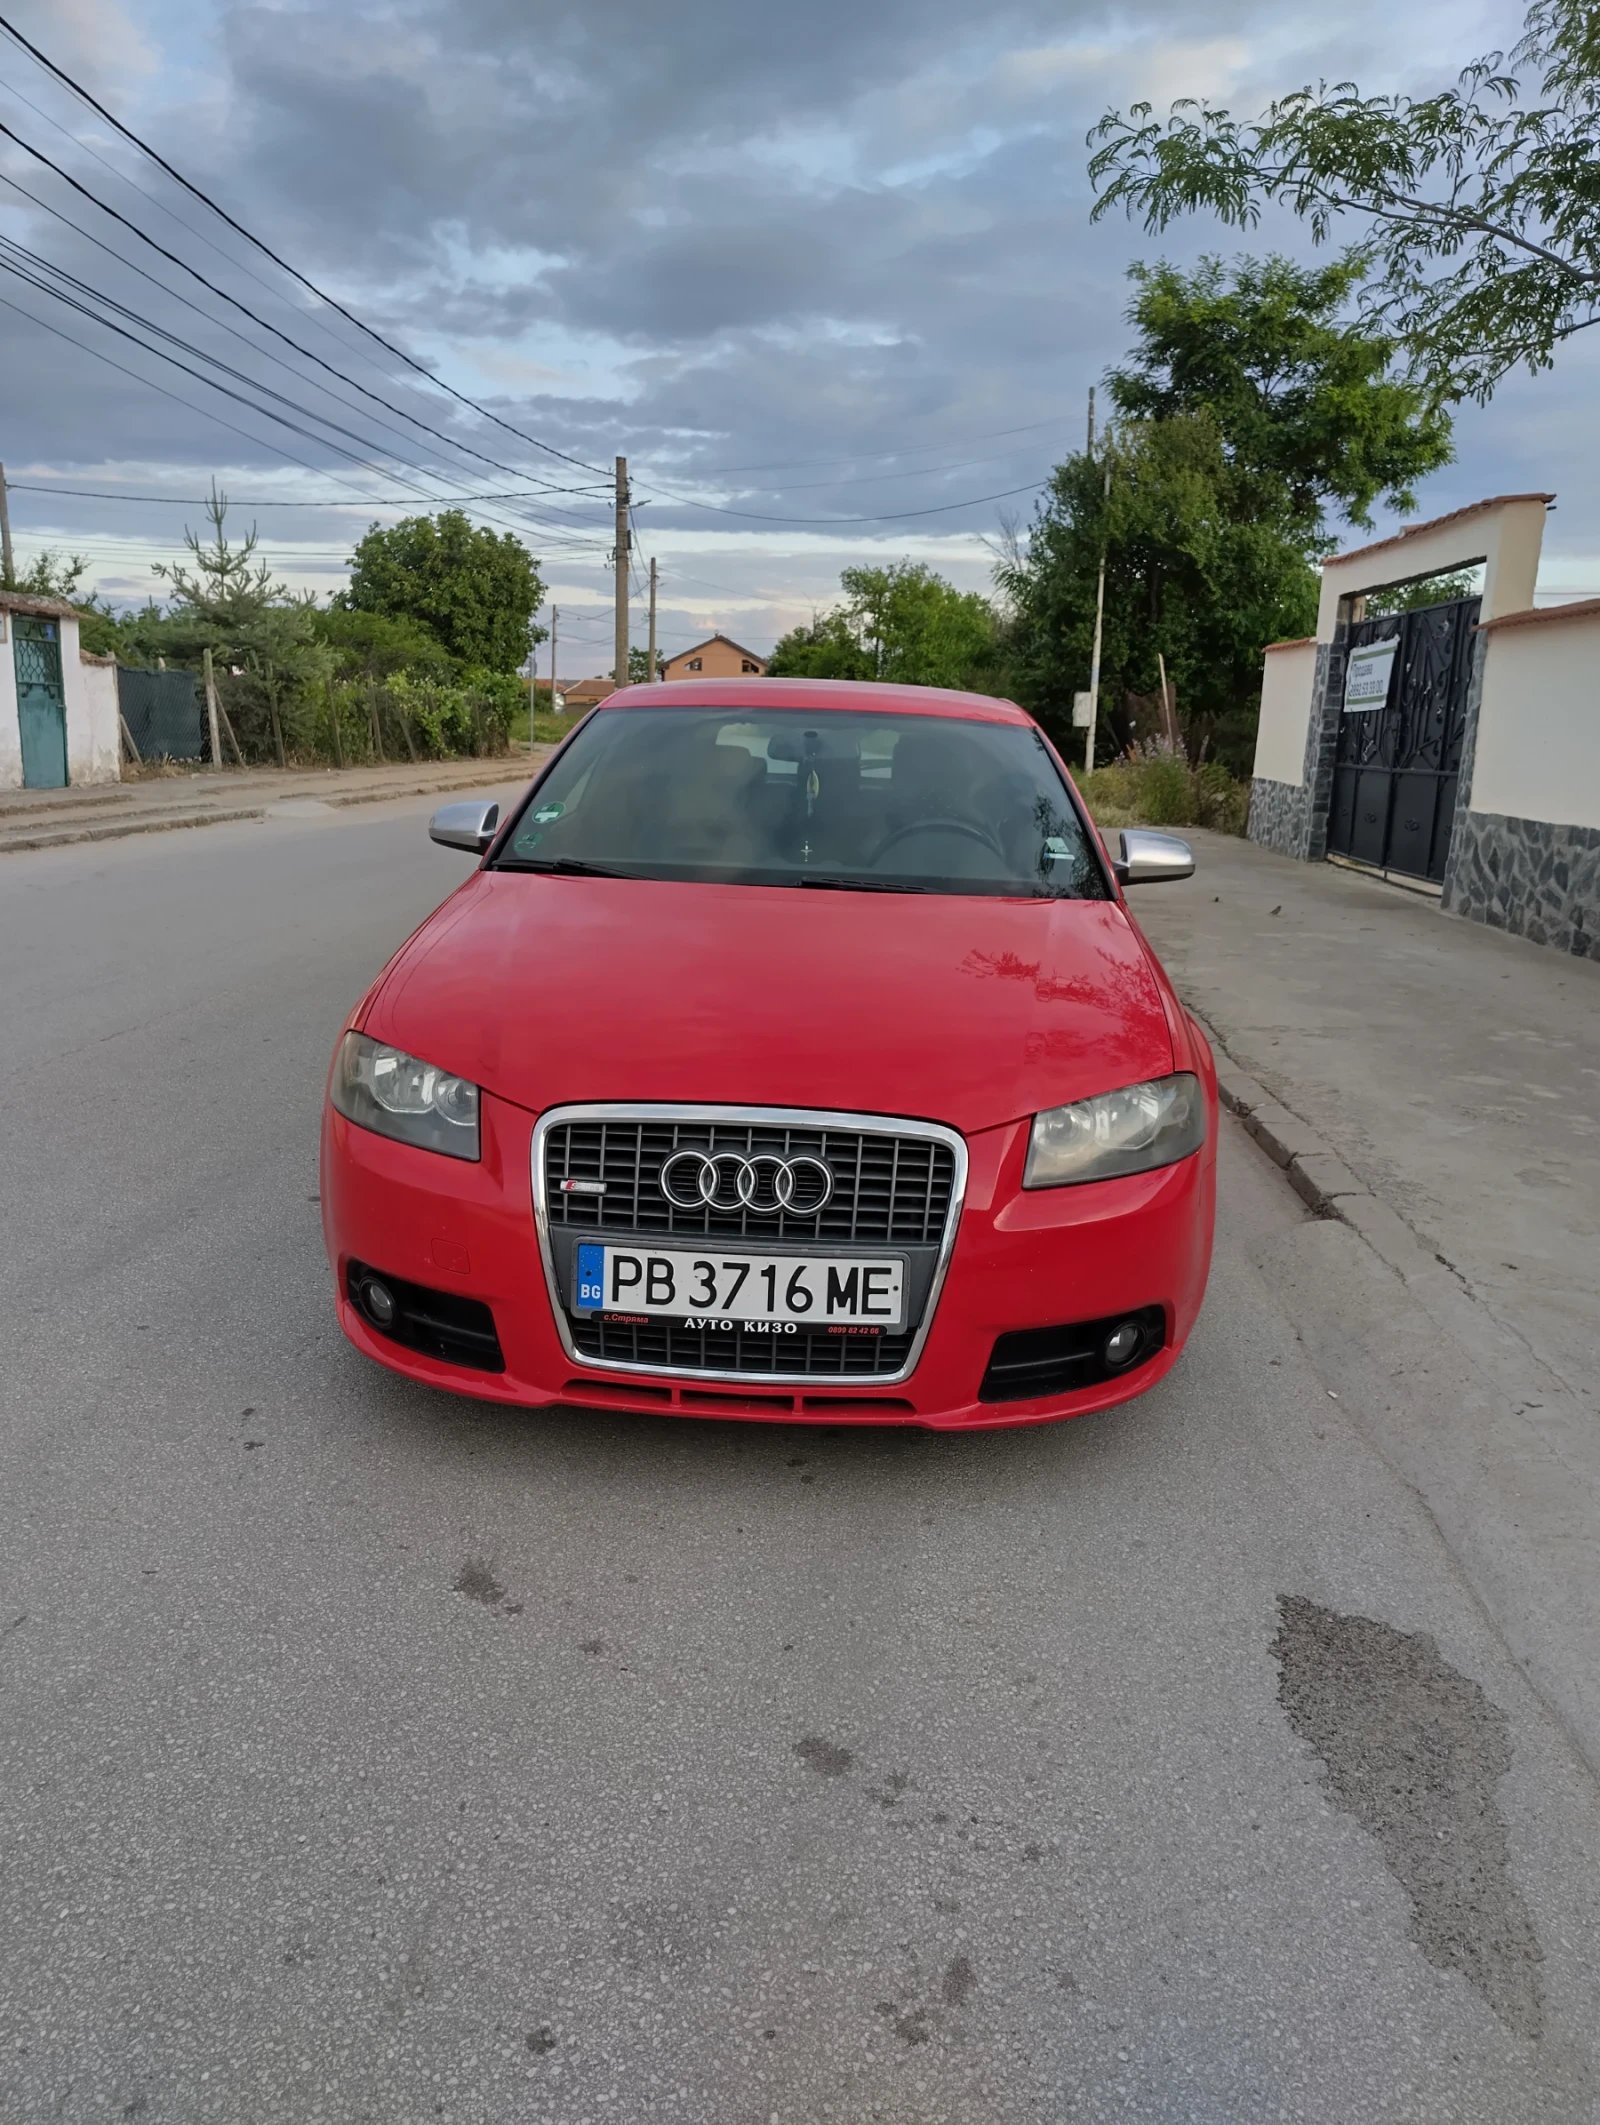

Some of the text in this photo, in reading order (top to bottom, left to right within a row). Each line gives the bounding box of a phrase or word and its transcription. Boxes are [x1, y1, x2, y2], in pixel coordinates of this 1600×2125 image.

[580, 1284, 601, 1299] BG
[612, 1255, 892, 1315] PB 3716 ME
[604, 1313, 649, 1324] с.Стряма
[684, 1317, 797, 1334] АУТО КИЗО
[828, 1326, 847, 1334] 0899
[858, 1327, 869, 1335] 42
